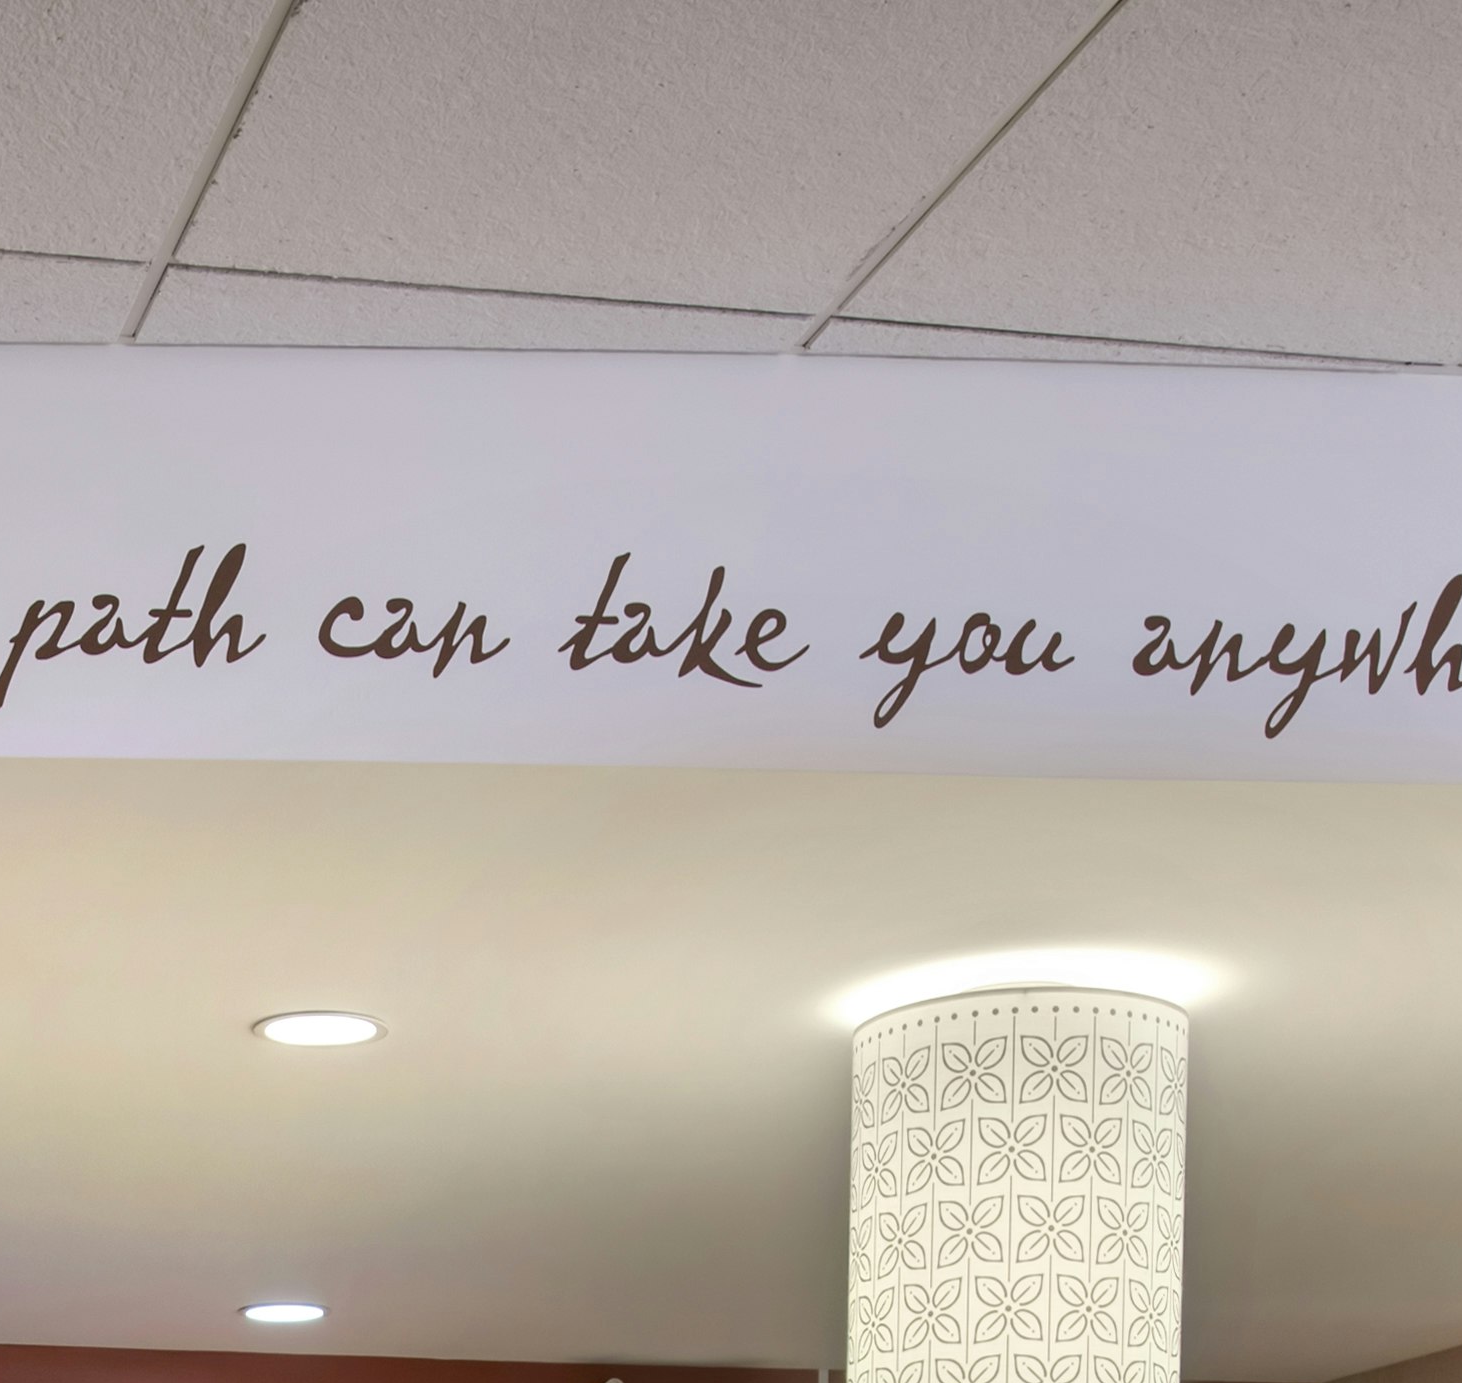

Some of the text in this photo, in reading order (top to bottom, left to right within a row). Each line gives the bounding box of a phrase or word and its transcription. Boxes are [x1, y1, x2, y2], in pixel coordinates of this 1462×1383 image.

[319, 597, 510, 678] can
[558, 553, 809, 687] take
[860, 613, 1074, 728] you
